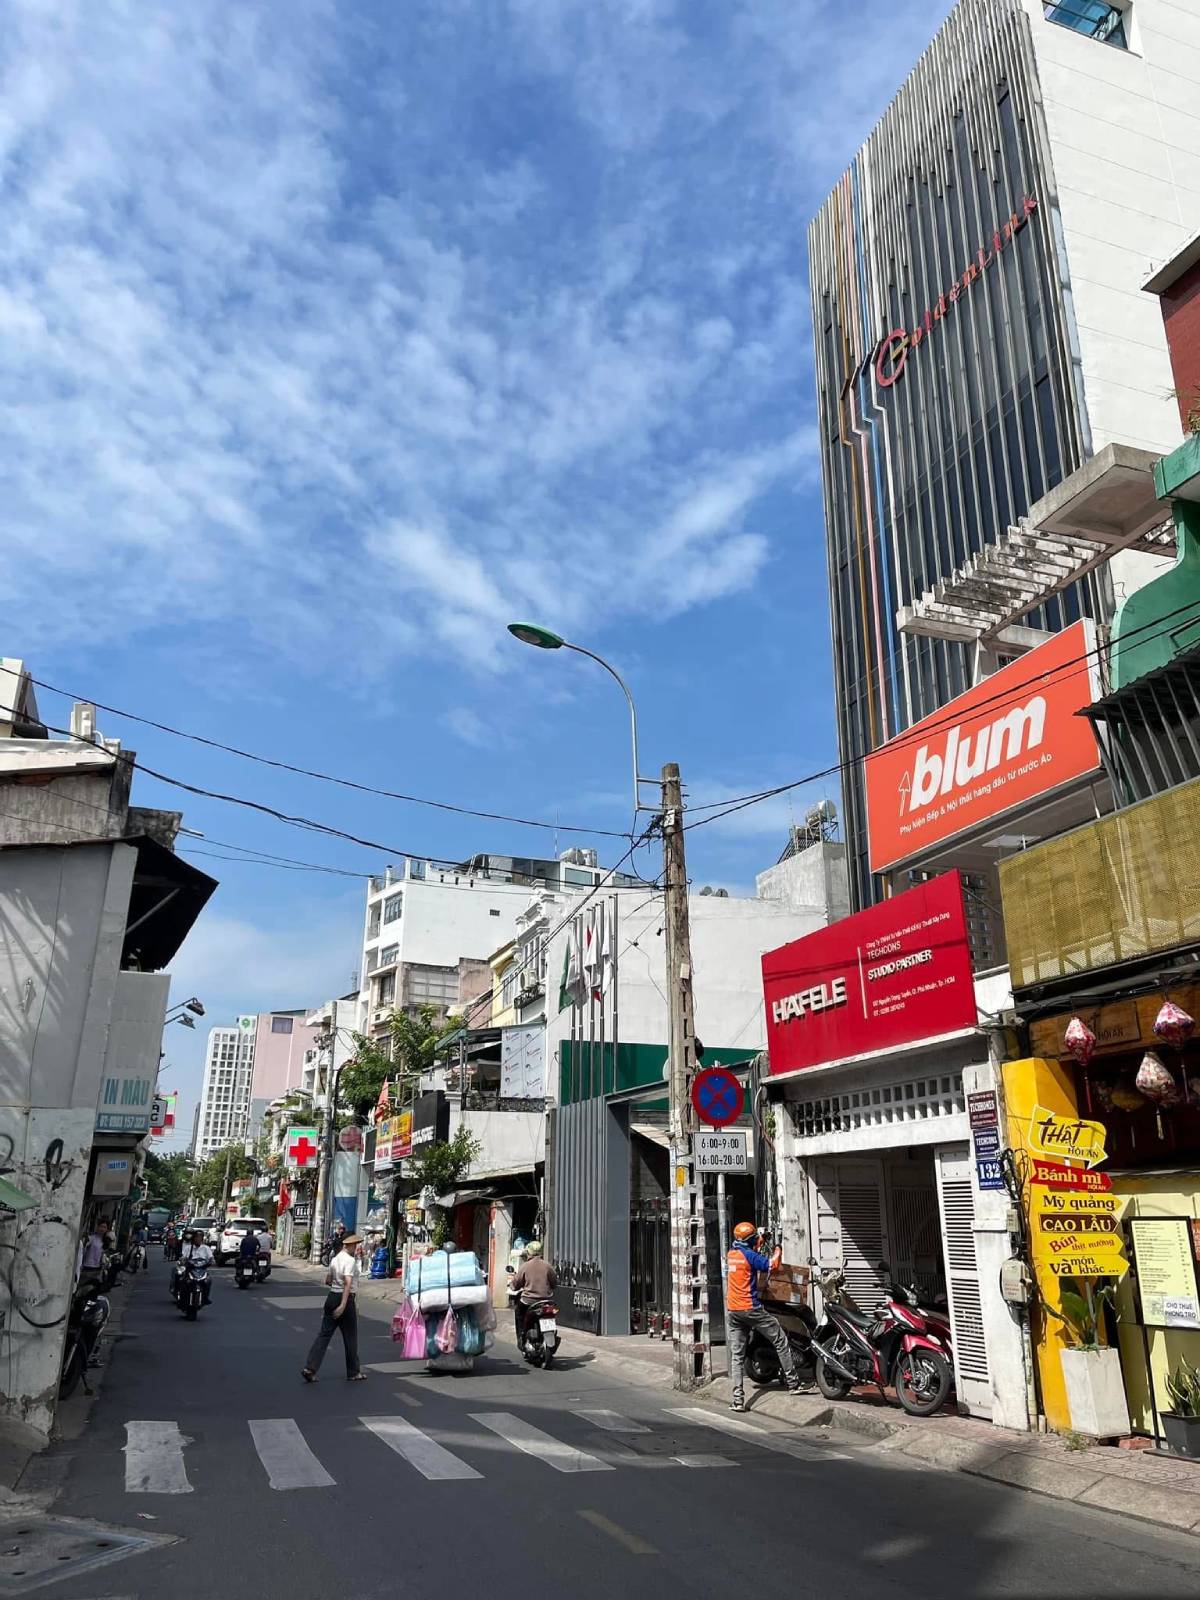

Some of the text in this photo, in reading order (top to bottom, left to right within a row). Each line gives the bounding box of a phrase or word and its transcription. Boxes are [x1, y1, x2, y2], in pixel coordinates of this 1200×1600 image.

[908, 695, 1046, 812] blum
[867, 940, 901, 960] TECHCONS
[868, 949, 932, 980] STUDIO PARTNER
[103, 1078, 119, 1104] IN
[701, 1138, 739, 1149] 6:00-9:00
[697, 1154, 744, 1165] 16:00-20:00
[979, 1162, 1001, 1179] 132
[1037, 1167, 1102, 1184] Bánh mì
[1043, 1194, 1115, 1212] Mỳ quảng
[1042, 1213, 1112, 1231] CAO LẦU
[1049, 1235, 1078, 1253] Bún
[1071, 1242, 1086, 1252] thịt
[1049, 1255, 1095, 1274] và món
[1080, 1264, 1105, 1274] khác
